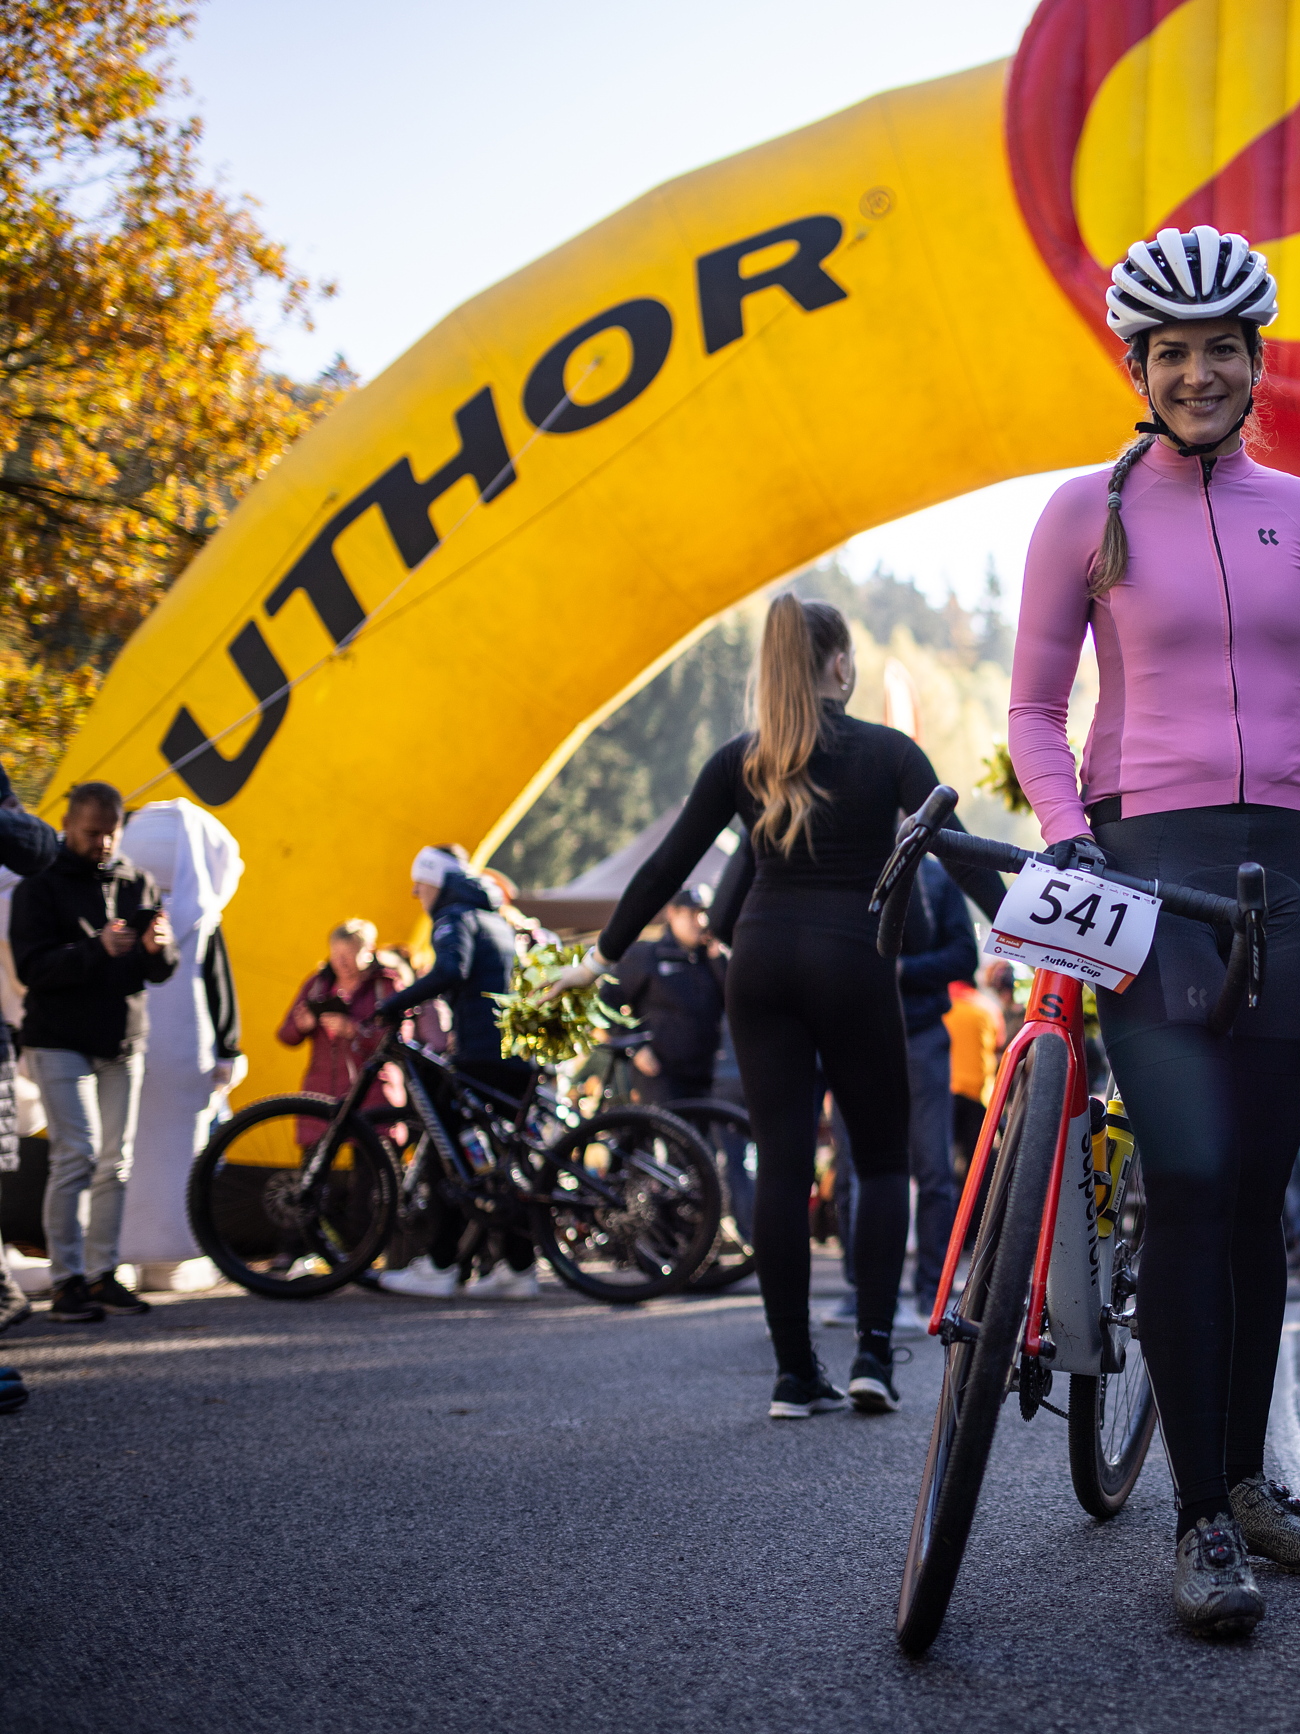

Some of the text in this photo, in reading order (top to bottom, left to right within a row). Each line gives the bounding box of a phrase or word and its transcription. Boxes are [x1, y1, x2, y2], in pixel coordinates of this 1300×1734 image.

[161, 214, 848, 806] UTHOR
[1029, 879, 1128, 947] 541
[1040, 955, 1079, 970] Author
[1080, 965, 1102, 978] Cup
